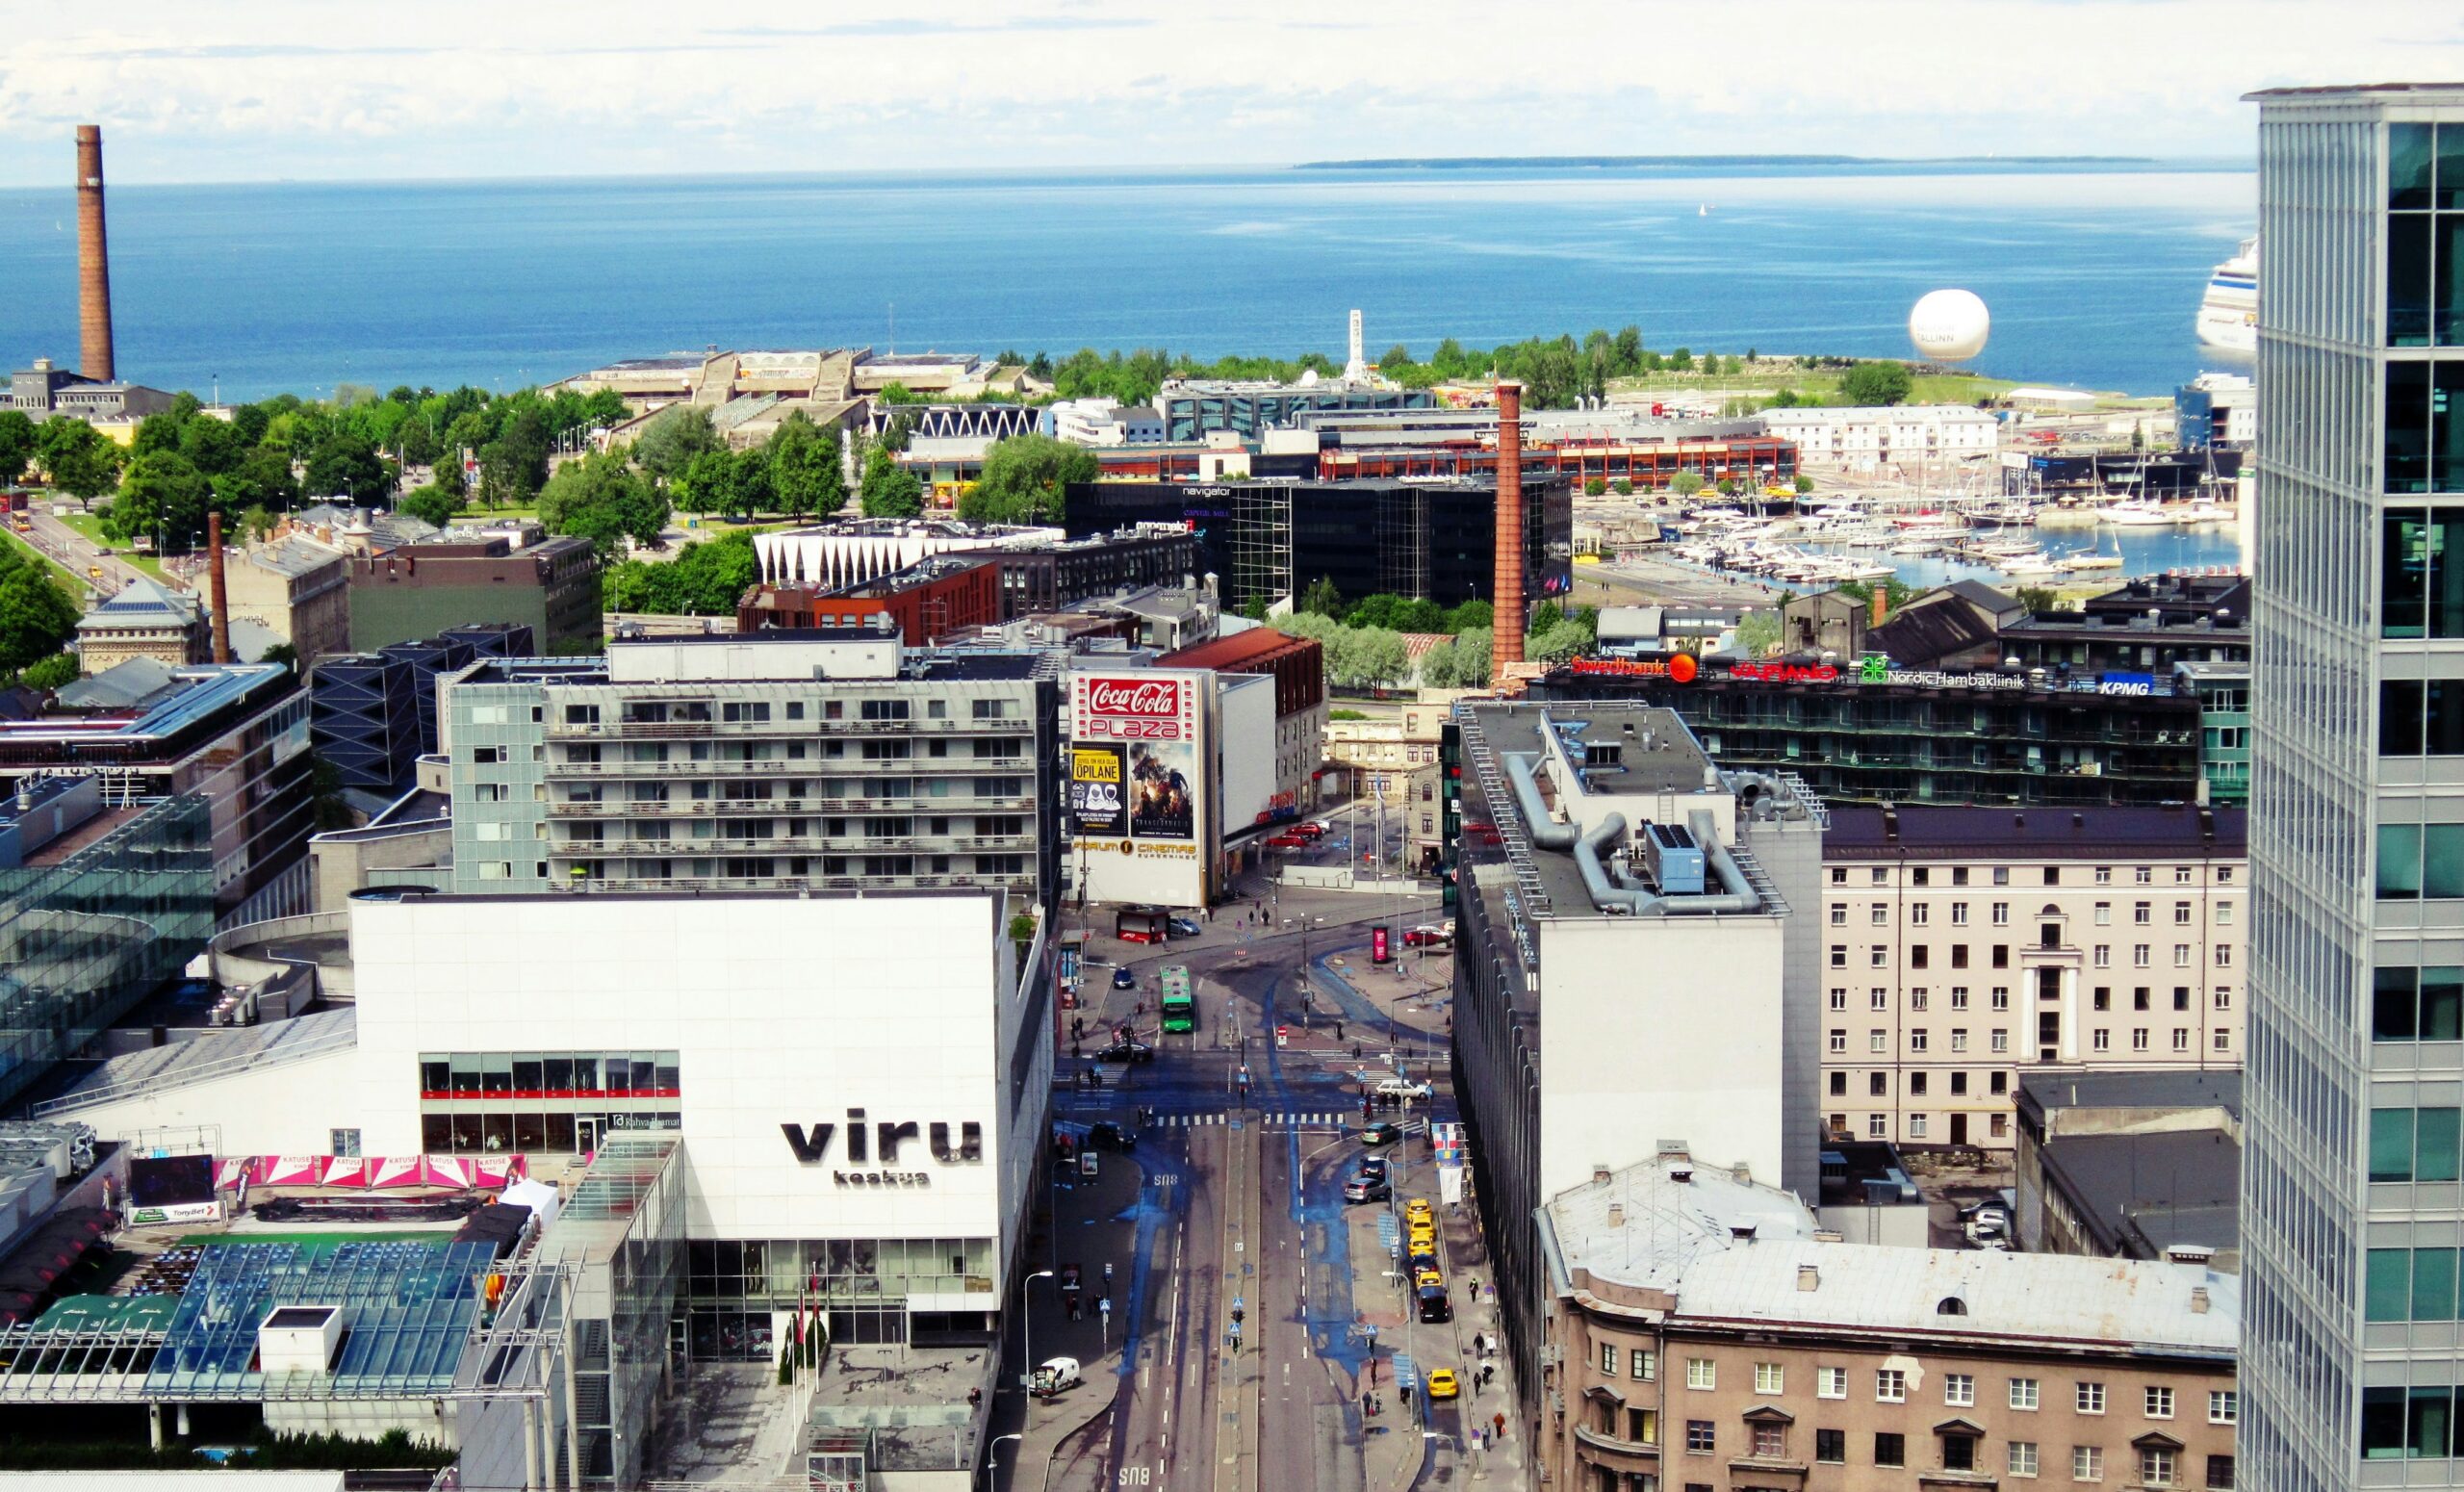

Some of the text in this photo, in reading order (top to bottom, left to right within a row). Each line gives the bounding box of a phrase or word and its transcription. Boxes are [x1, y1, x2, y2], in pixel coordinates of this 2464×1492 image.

[1917, 333, 1954, 343] TALLINN
[1183, 487, 1230, 498] navigator
[1572, 655, 1665, 675] Swedbank
[1730, 661, 1838, 682] VAPIANO
[1887, 671, 2025, 687] Nordic Hambakliinik
[2100, 682, 2149, 695] KPMG
[1091, 682, 1174, 713] Coca-Cola
[1076, 764, 1117, 779] ÕPILANE
[1138, 843, 1196, 855] CINEMAS
[626, 1118, 650, 1127] Rahva
[781, 1107, 981, 1163] viru
[337, 1158, 361, 1167] KATUSE
[834, 1170, 930, 1184] keskus
[1154, 1174, 1178, 1186] BUS
[174, 1208, 205, 1217] TonyBet
[1118, 1467, 1150, 1485] BUS
